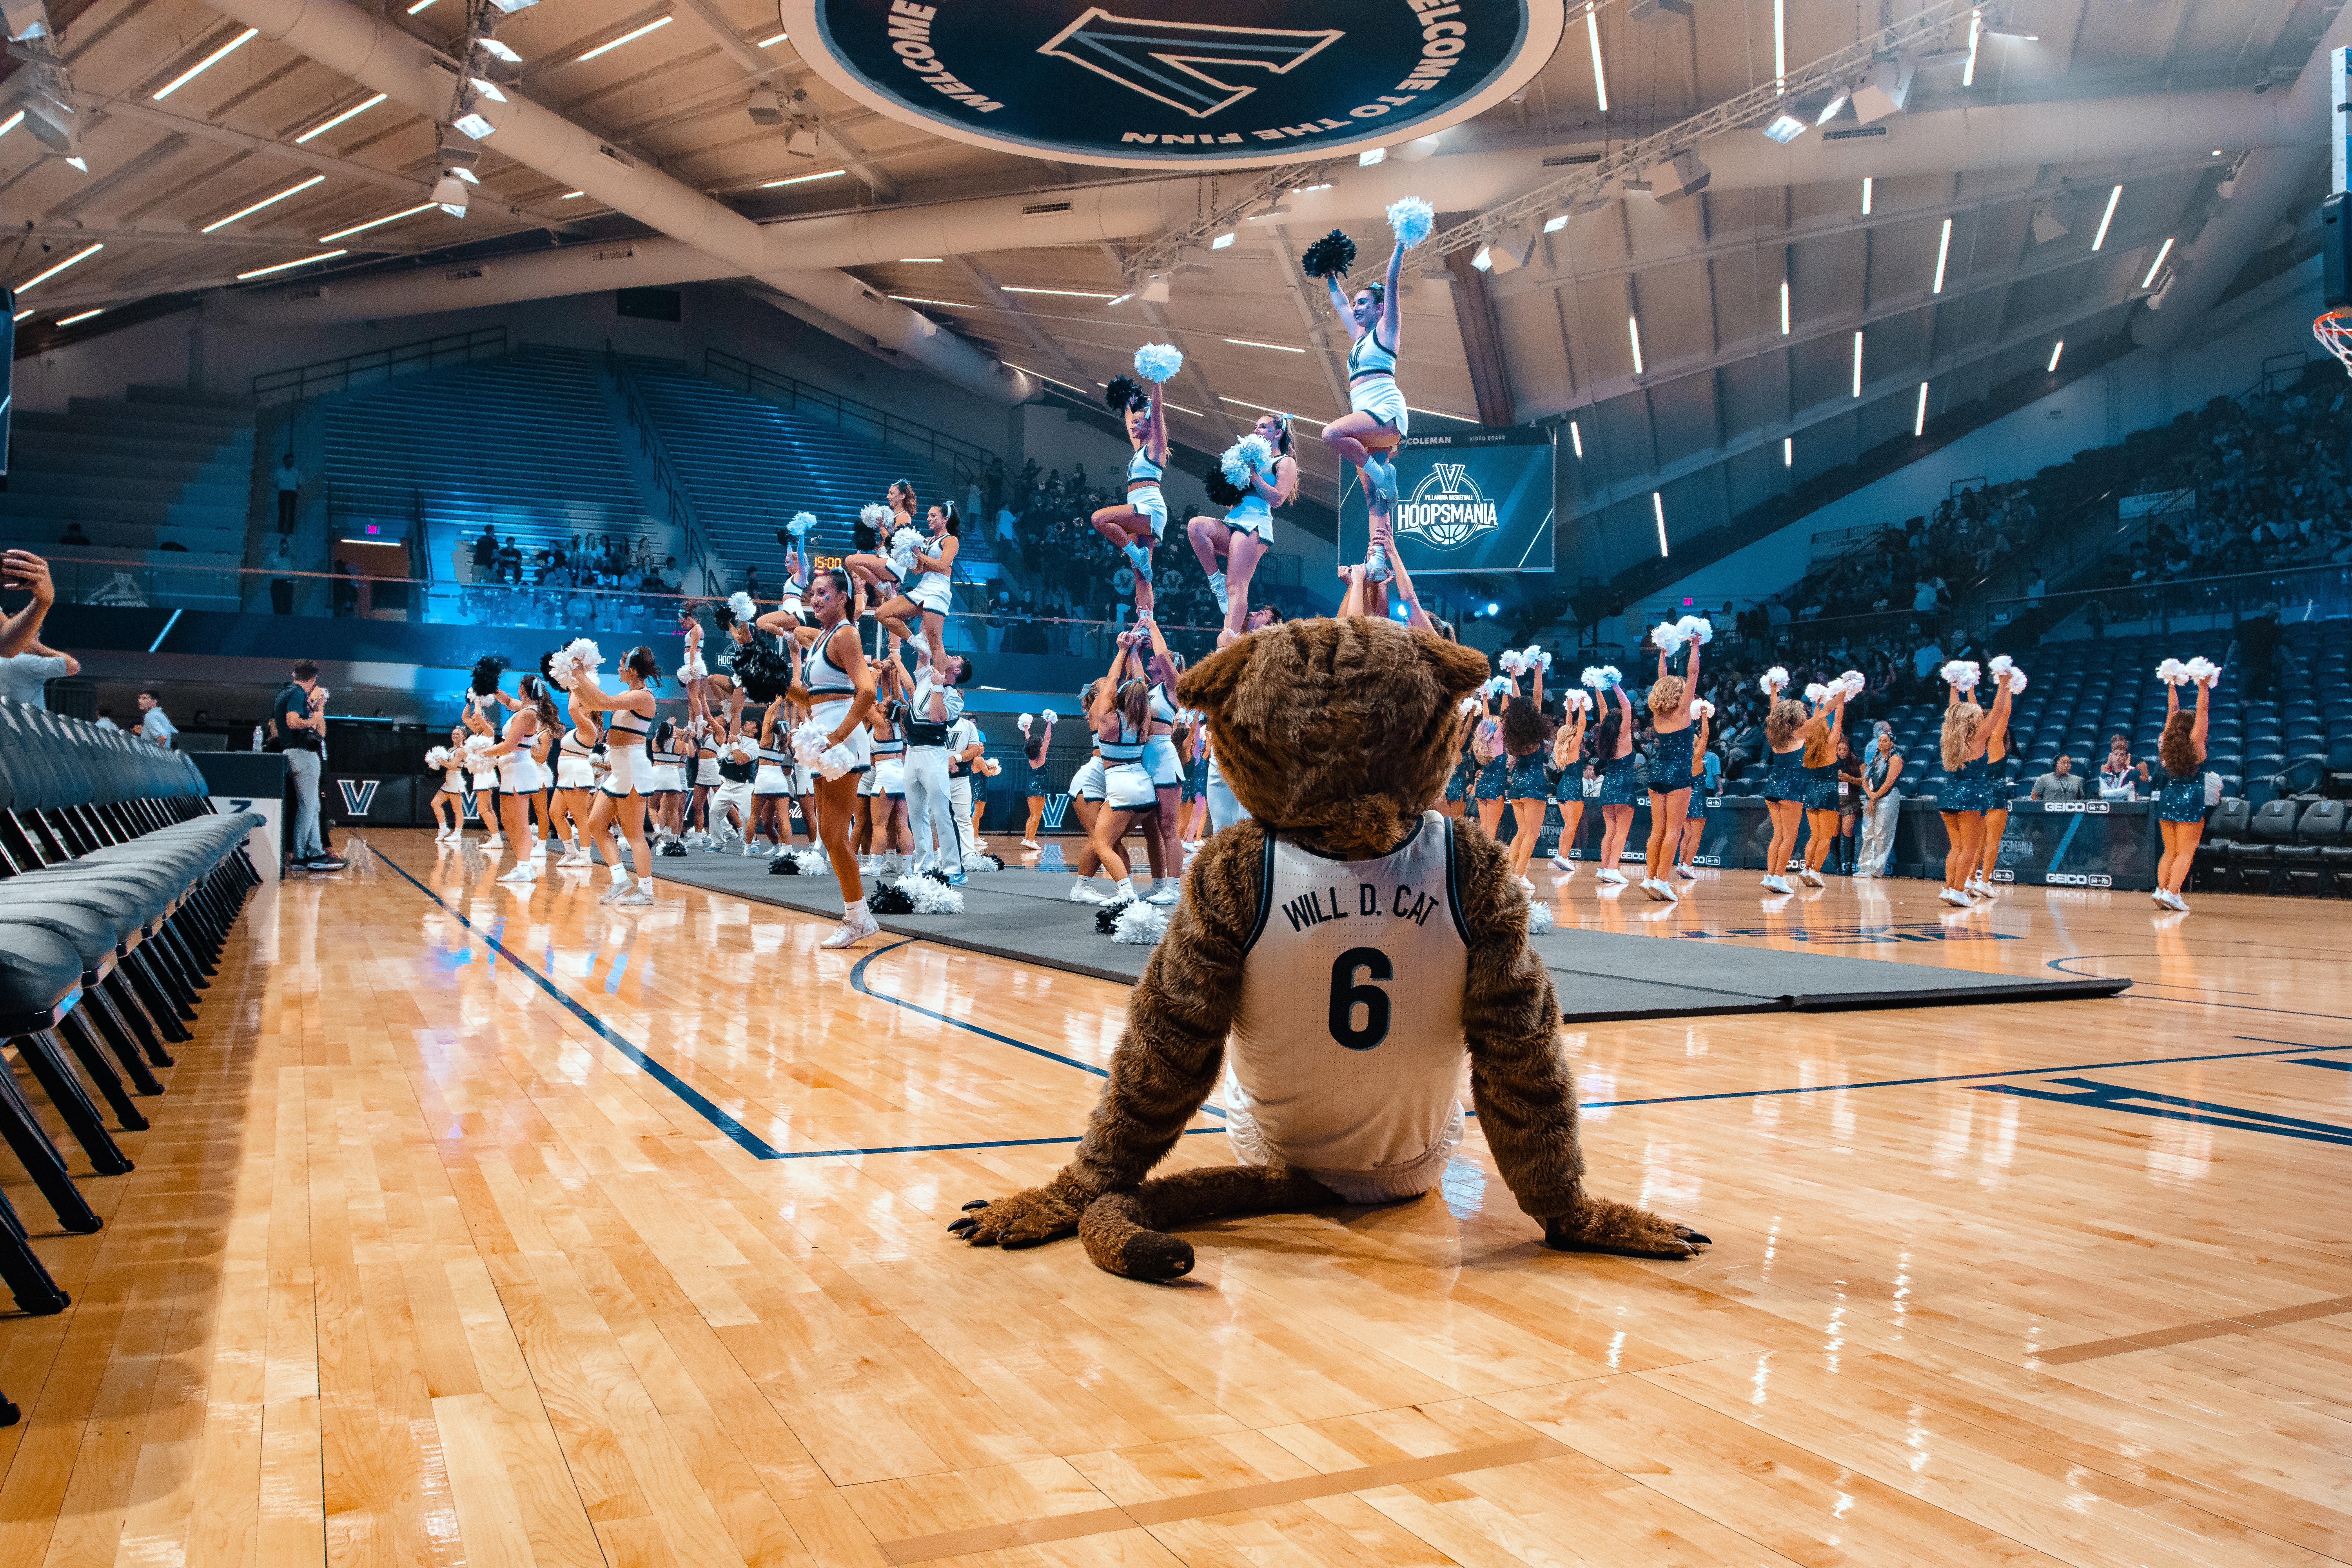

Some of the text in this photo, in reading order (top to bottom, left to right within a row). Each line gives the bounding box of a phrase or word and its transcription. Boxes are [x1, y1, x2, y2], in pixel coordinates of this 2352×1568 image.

[888, 0, 1005, 113] WELCOME
[1121, 0, 1467, 144] ELCOME TO THE FINN
[1406, 436, 1451, 445] COLEMAN
[1398, 503, 1497, 530] HOOPSMANIA
[814, 556, 842, 569] 15:00
[2044, 802, 2085, 812] GEICO
[2046, 873, 2087, 884] GEICO
[1282, 884, 1439, 932] WILL D. CAT
[1328, 947, 1393, 1051] 6
